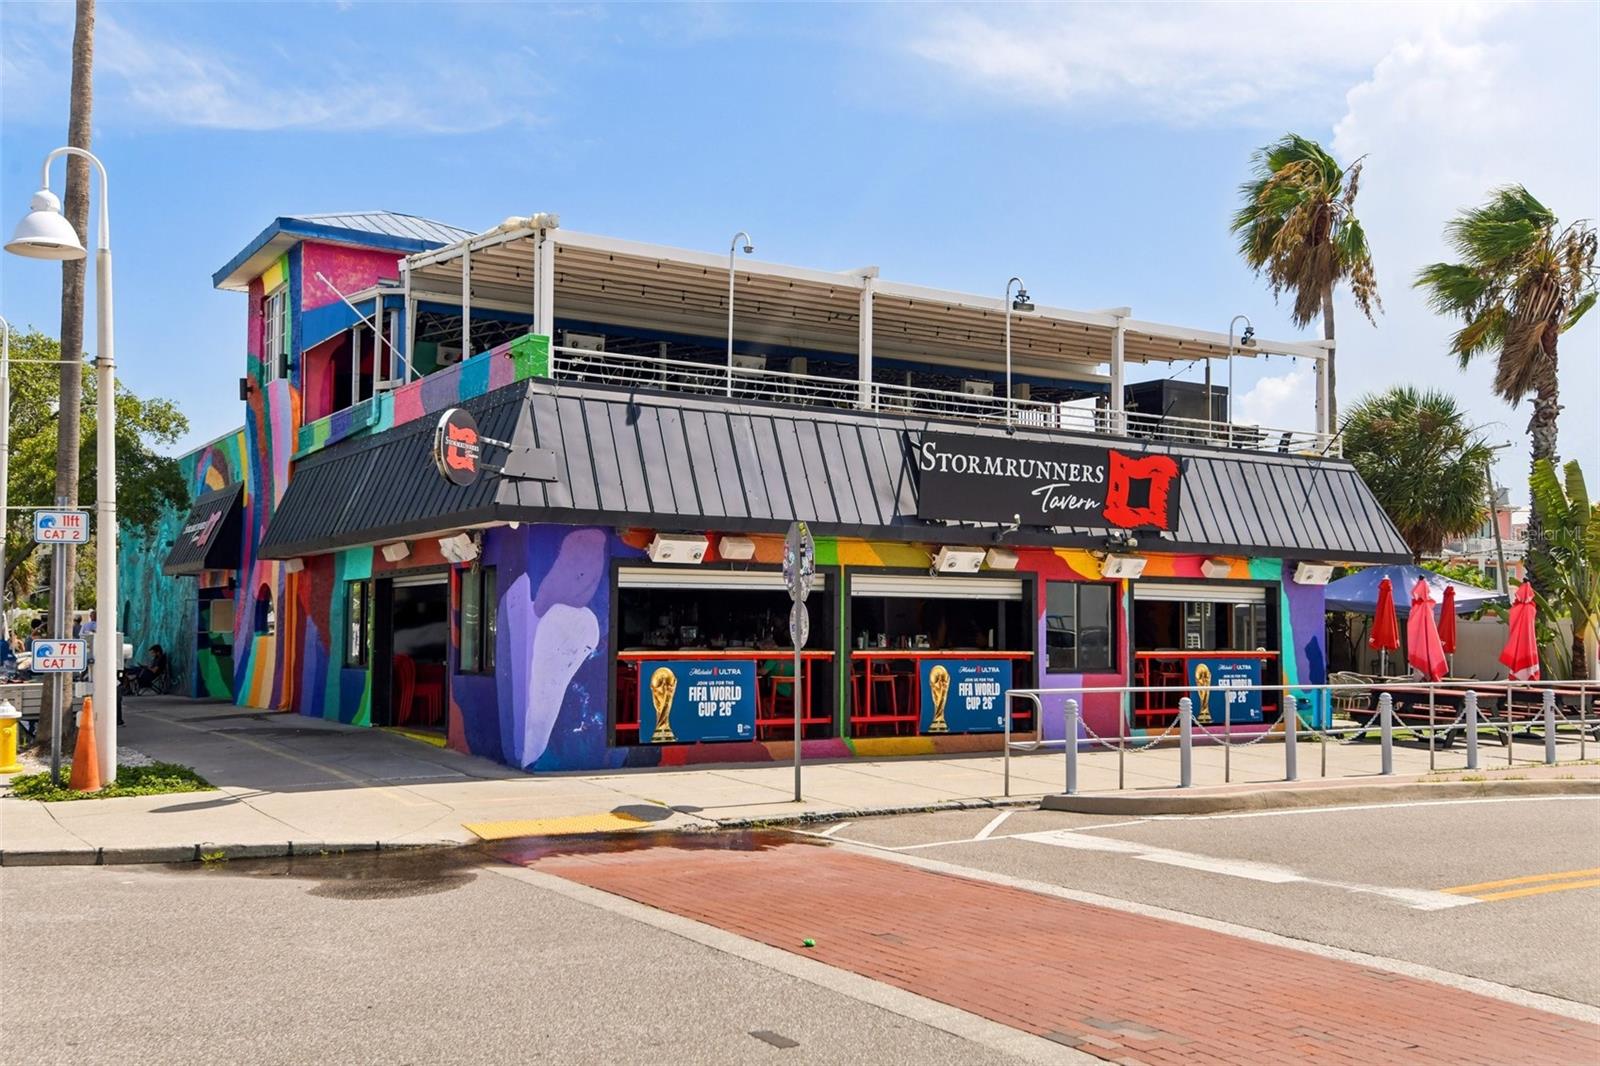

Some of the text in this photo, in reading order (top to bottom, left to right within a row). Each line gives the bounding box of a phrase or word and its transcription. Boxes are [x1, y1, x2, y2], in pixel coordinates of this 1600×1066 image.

[920, 441, 1105, 484] STORMRUNNERS
[1031, 483, 1101, 513] Tavern
[62, 515, 80, 527] 11ft
[44, 530, 80, 540] CAT 2
[60, 643, 77, 655] 7ft
[43, 659, 64, 668] CAT
[688, 685, 742, 702] FIFA WORLD
[958, 682, 1000, 696] FIFA WORLD
[698, 701, 717, 717] CUP
[966, 696, 981, 710] CUP
